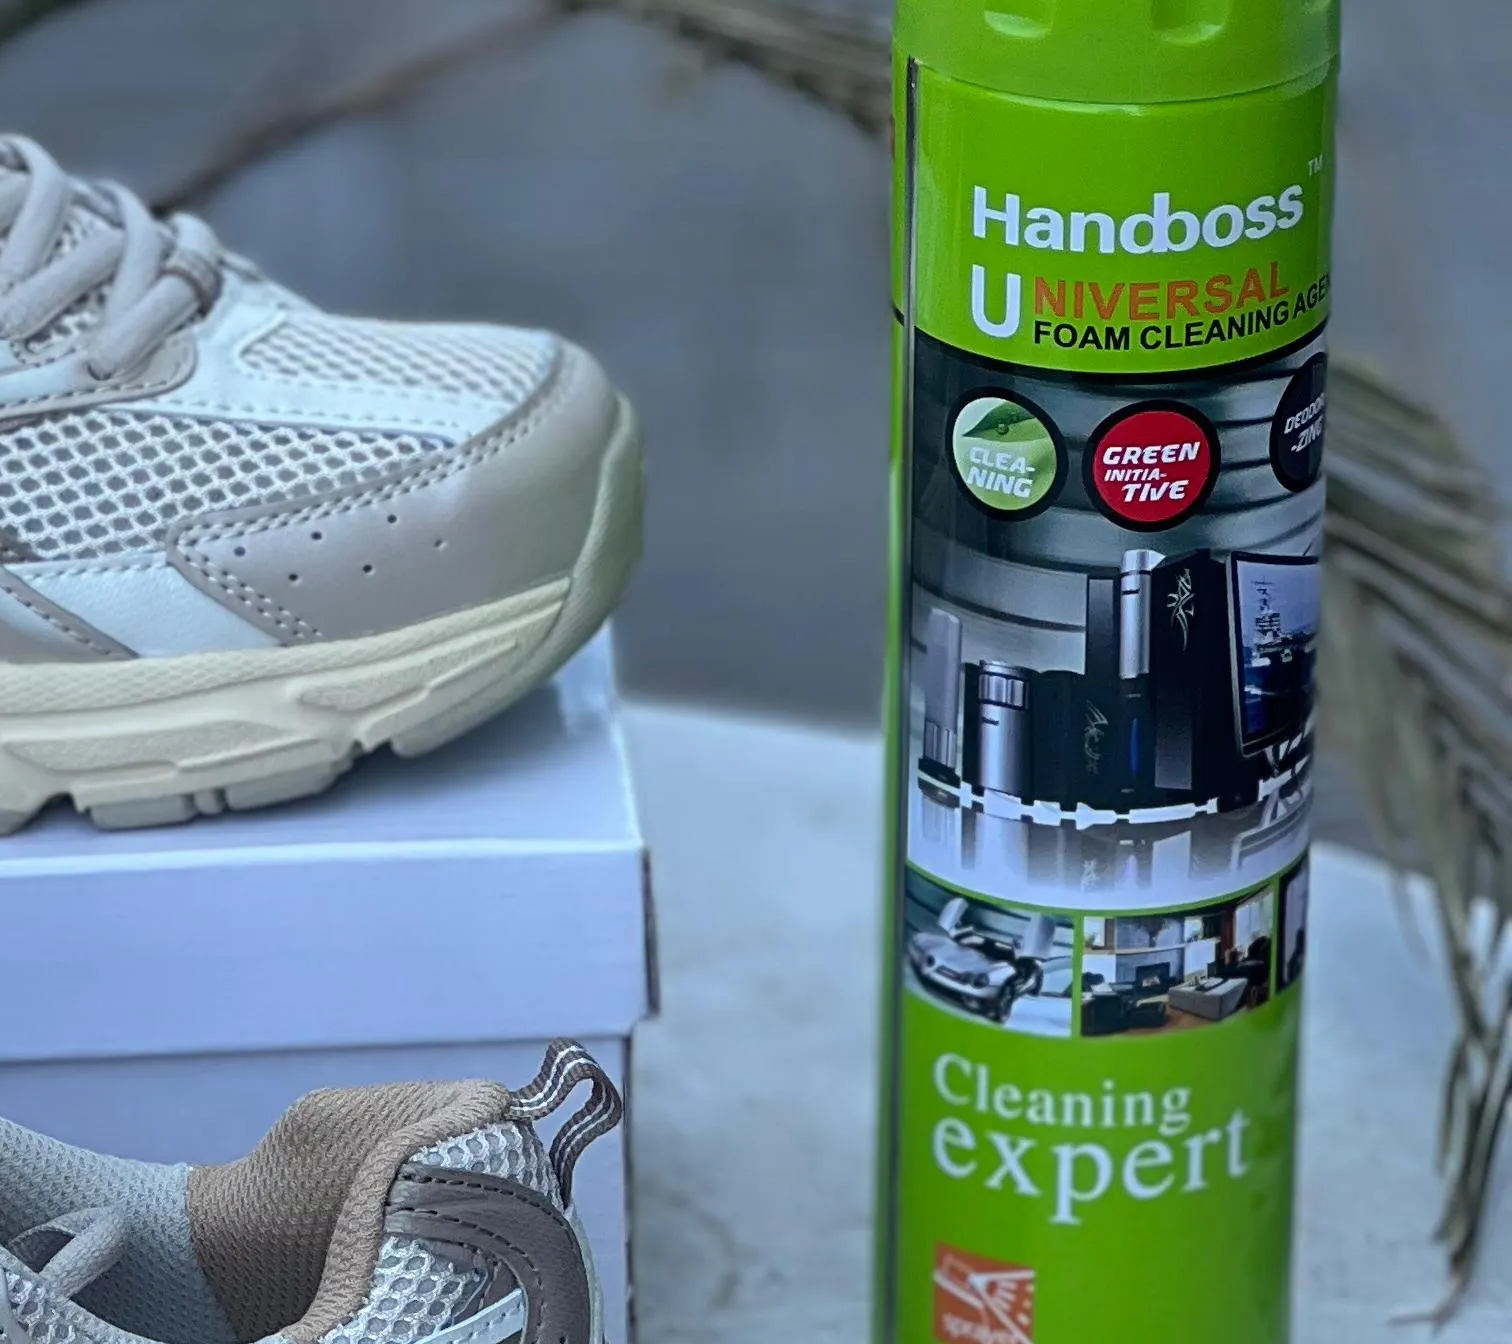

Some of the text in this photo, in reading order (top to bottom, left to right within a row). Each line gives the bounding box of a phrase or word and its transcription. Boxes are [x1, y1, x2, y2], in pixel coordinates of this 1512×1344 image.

[972, 185, 1304, 254] Handboss
[1033, 321, 1131, 351] FOAM
[1140, 300, 1289, 351] CLEANING
[968, 445, 1036, 475] CLEA-
[1102, 441, 1201, 466] GREEN
[966, 467, 1033, 498] NING
[1103, 467, 1167, 482] INITIA-
[1121, 479, 1190, 503] TIVE
[933, 1052, 1193, 1137] Cleaning
[932, 1107, 1252, 1225] expert
